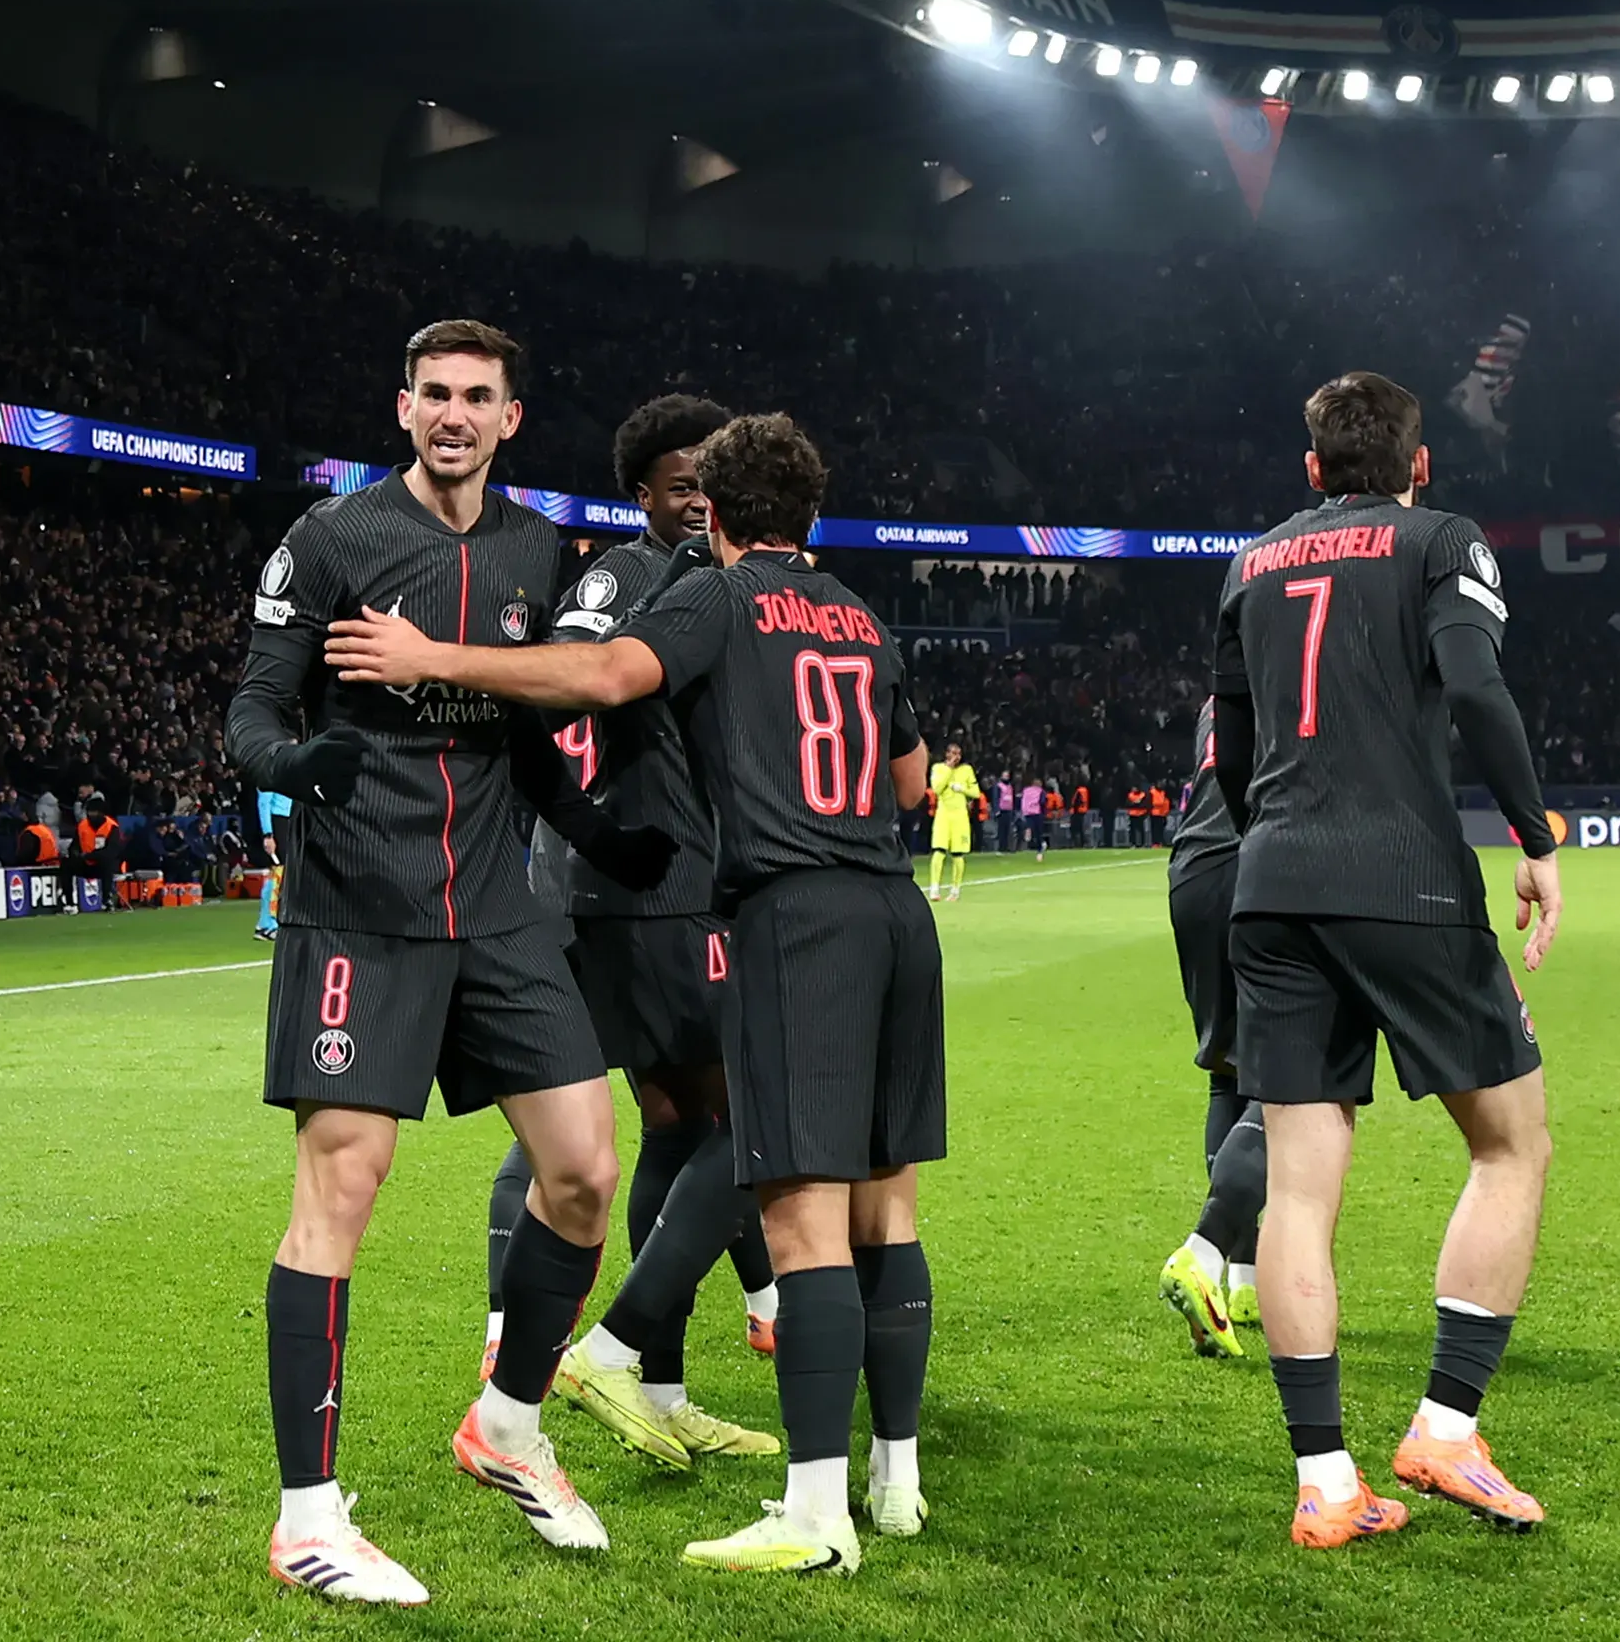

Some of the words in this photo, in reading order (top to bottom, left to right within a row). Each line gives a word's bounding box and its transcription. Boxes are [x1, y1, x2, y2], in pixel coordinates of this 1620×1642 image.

[91, 427, 125, 455] UEFA
[125, 432, 198, 466] CHAMPIONS
[197, 446, 245, 473] LEAGUE
[584, 504, 611, 524] UEFA
[875, 525, 914, 544] QATAR
[914, 527, 969, 545] AIRWAYS
[1152, 535, 1199, 554] UEFA
[1240, 524, 1397, 584] KVARATSKHELIA
[1284, 575, 1333, 739] 7
[793, 649, 881, 818] 87
[320, 955, 353, 1027] 8
